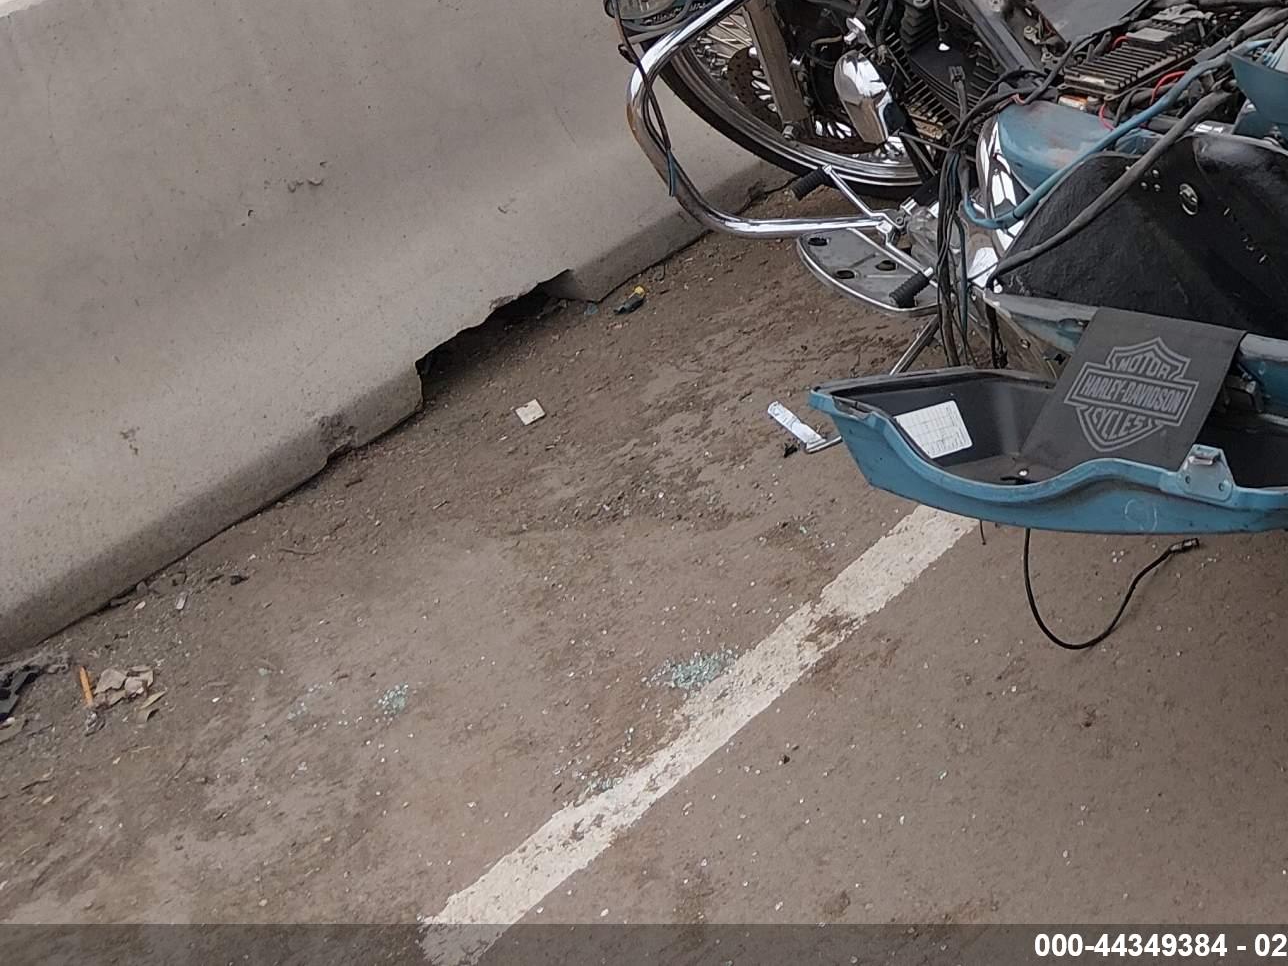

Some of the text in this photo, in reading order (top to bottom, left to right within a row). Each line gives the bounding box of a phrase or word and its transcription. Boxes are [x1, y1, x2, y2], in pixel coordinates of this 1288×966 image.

[1118, 351, 1170, 379] MOTOR
[1081, 374, 1185, 413] HARLEY-DAVIDSON
[1092, 408, 1146, 440] CYCLES
